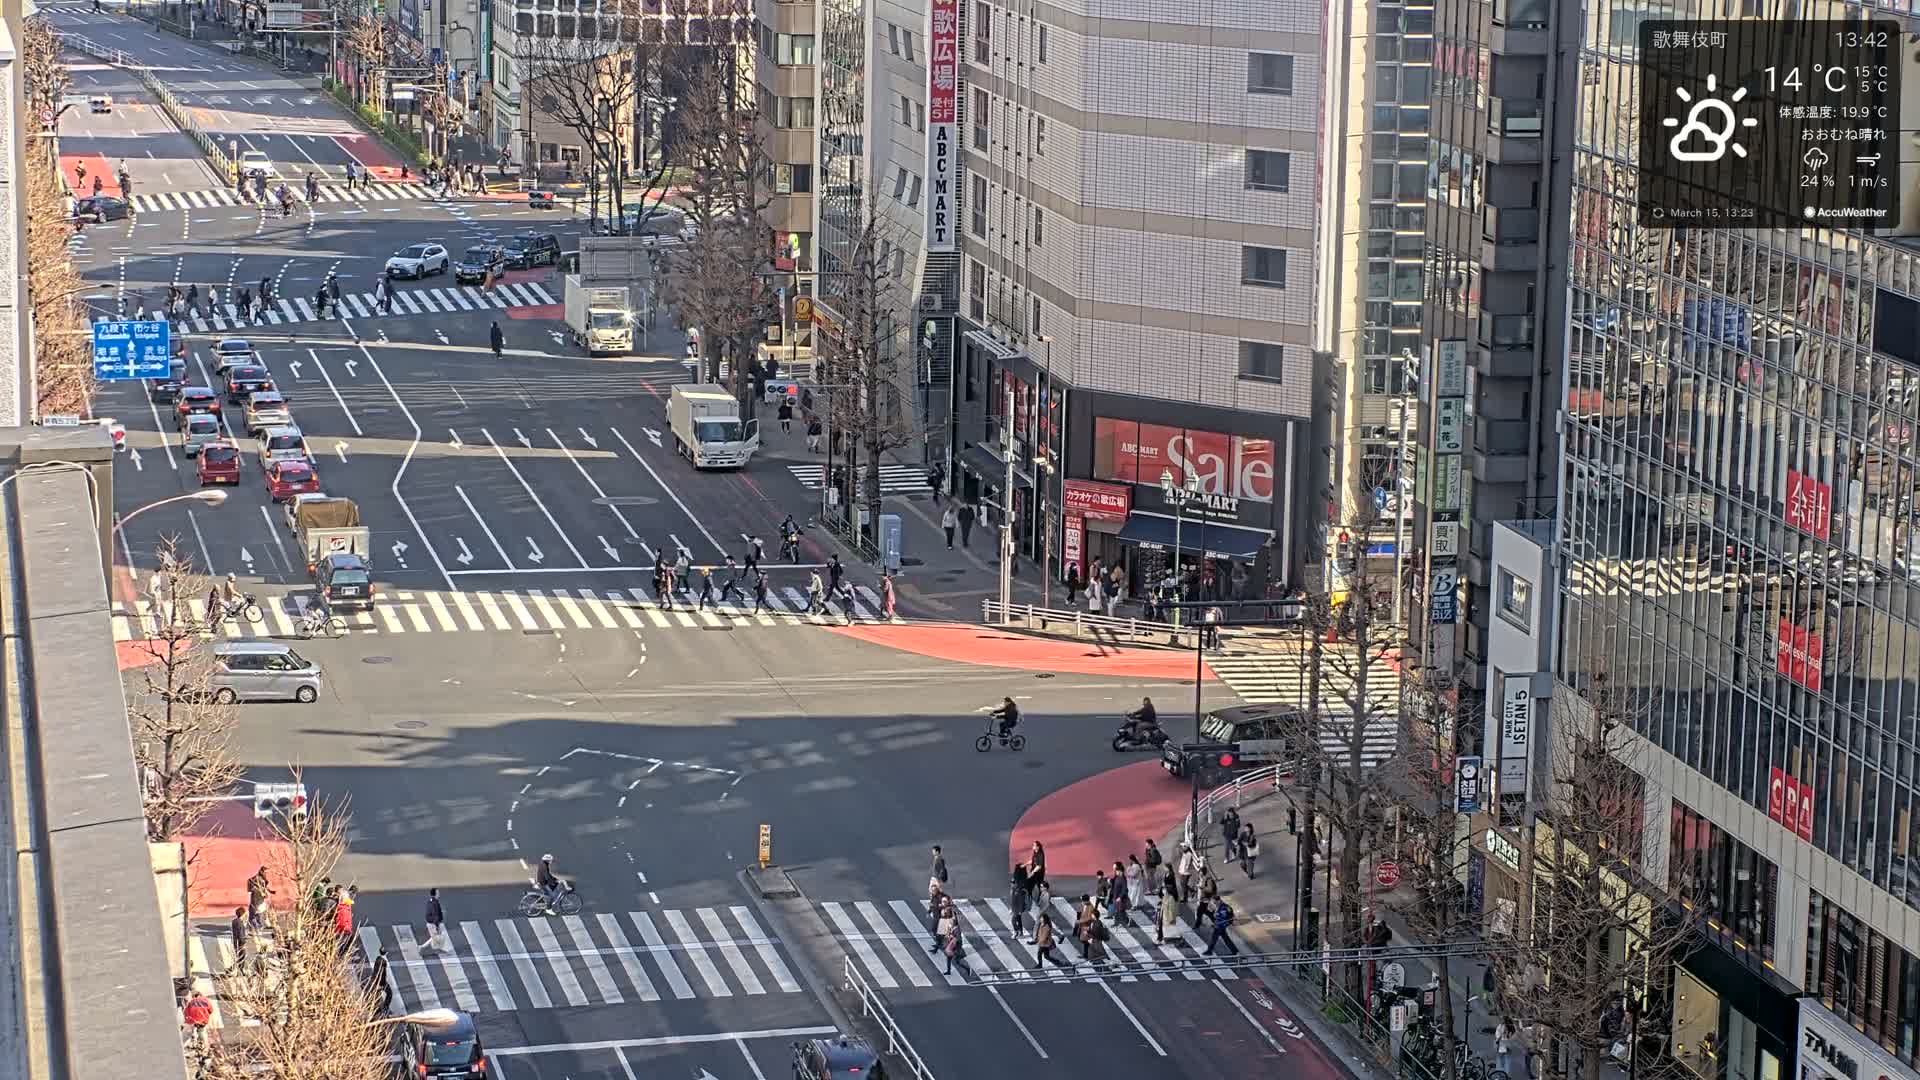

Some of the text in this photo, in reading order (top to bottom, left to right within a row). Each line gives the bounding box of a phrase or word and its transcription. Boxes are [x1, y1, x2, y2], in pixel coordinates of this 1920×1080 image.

[933, 0, 955, 90] 歌広場
[932, 97, 954, 108] 受付
[932, 108, 953, 119] 5F
[100, 324, 128, 333] 九段下
[1121, 442, 1159, 456] ABCMART
[1167, 434, 1273, 501] Sale
[1066, 491, 1125, 508] カラオケの歌広場
[1791, 479, 1826, 531] 会計
[1440, 513, 1451, 521] 7F
[1435, 525, 1449, 553] 買取
[1513, 690, 1528, 745] ISETAN 5
[1505, 718, 1513, 739] PARK
[1772, 778, 1811, 828] CPA
